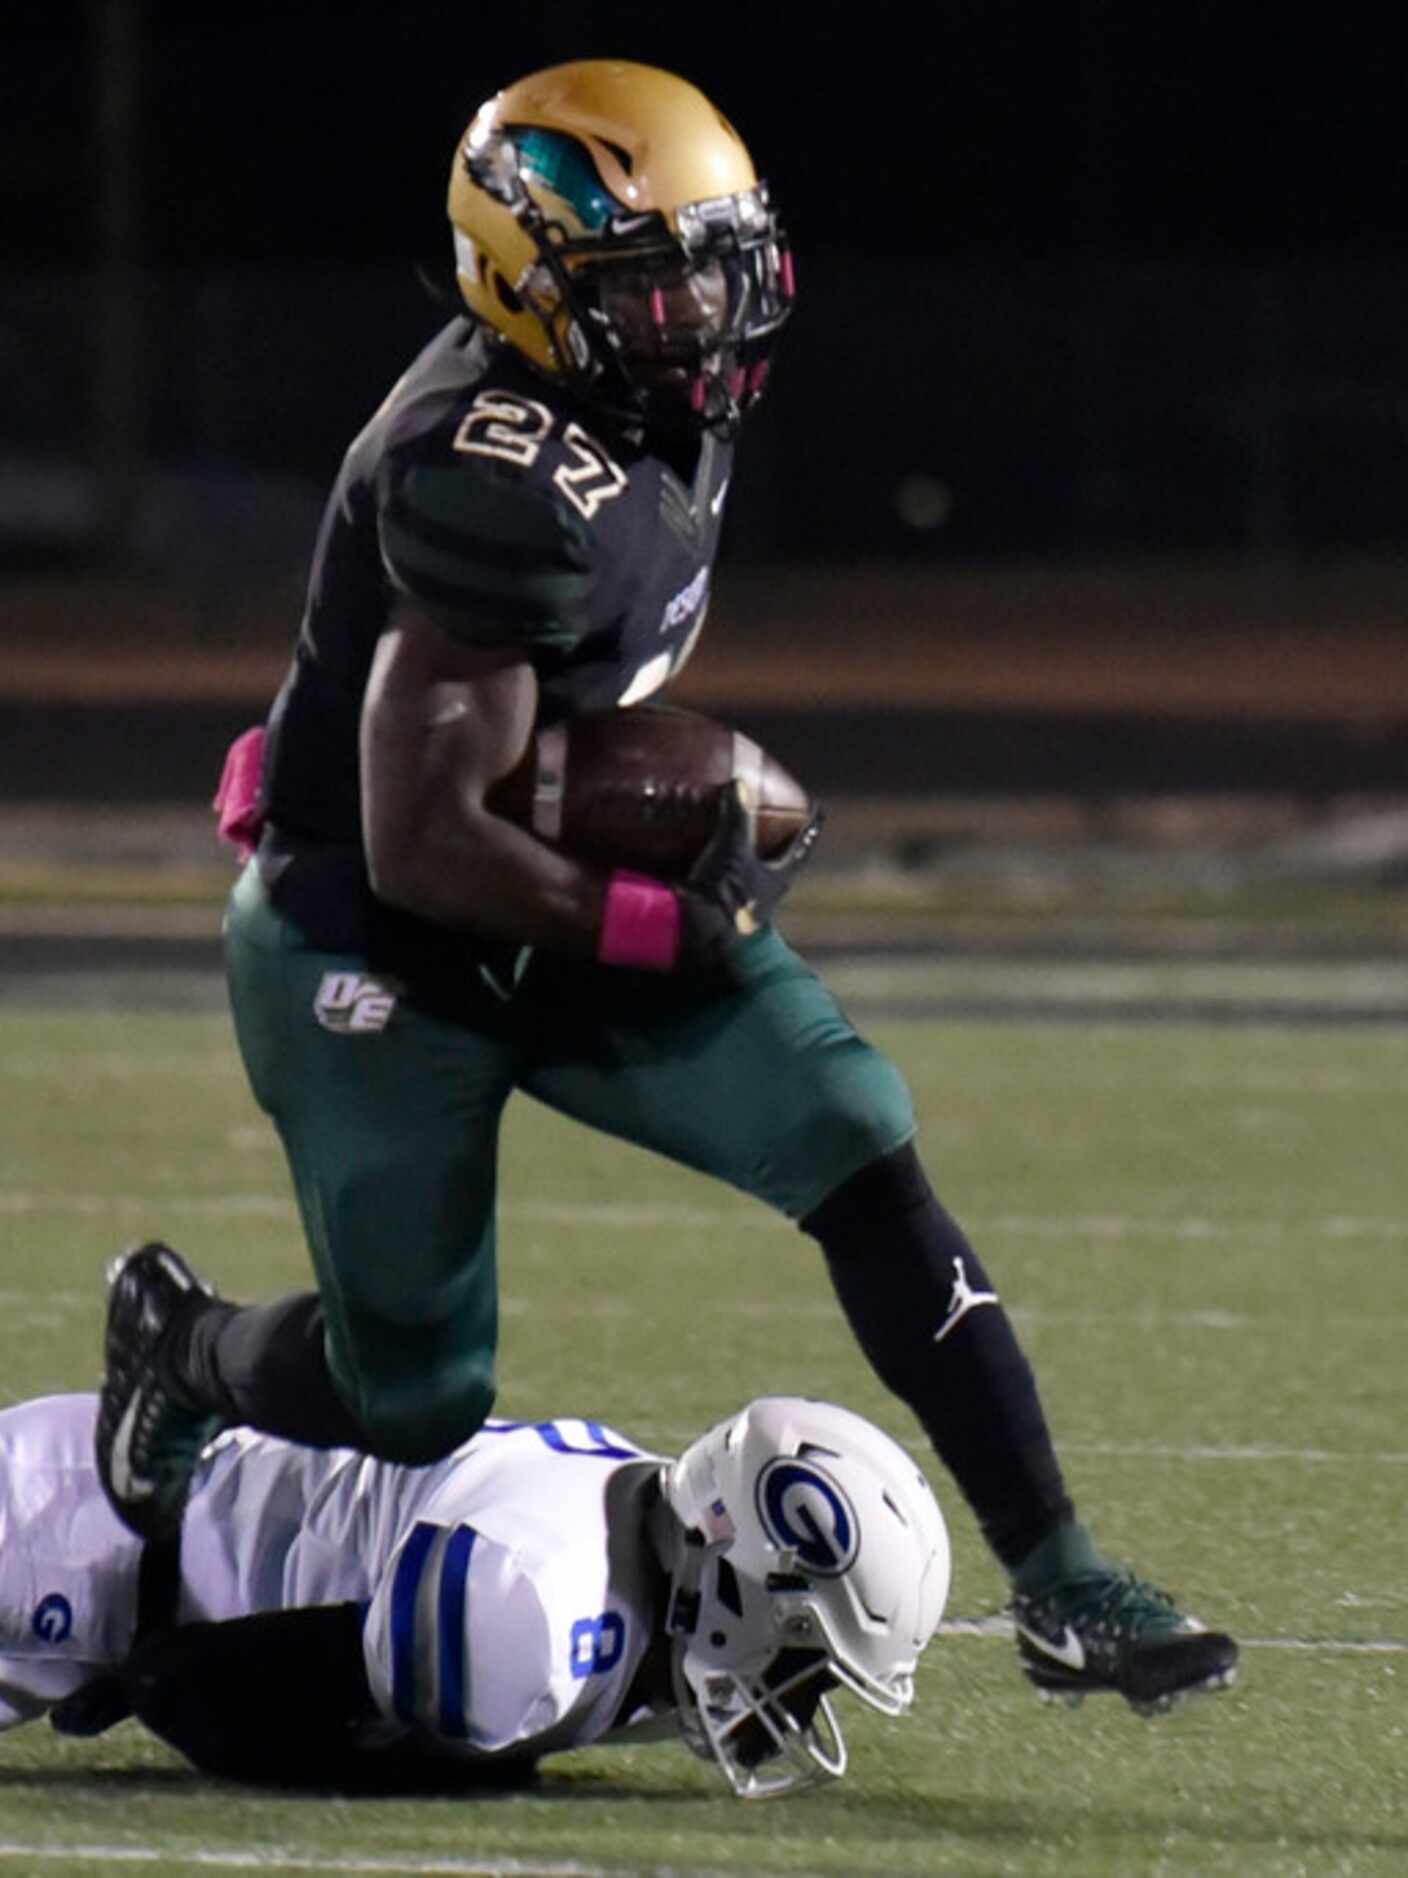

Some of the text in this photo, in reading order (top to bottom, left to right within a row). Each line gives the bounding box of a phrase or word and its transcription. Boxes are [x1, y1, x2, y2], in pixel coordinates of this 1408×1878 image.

[454, 389, 629, 519] 27
[762, 1463, 852, 1570] G
[32, 1593, 72, 1643] G
[569, 1611, 625, 1680] 8
